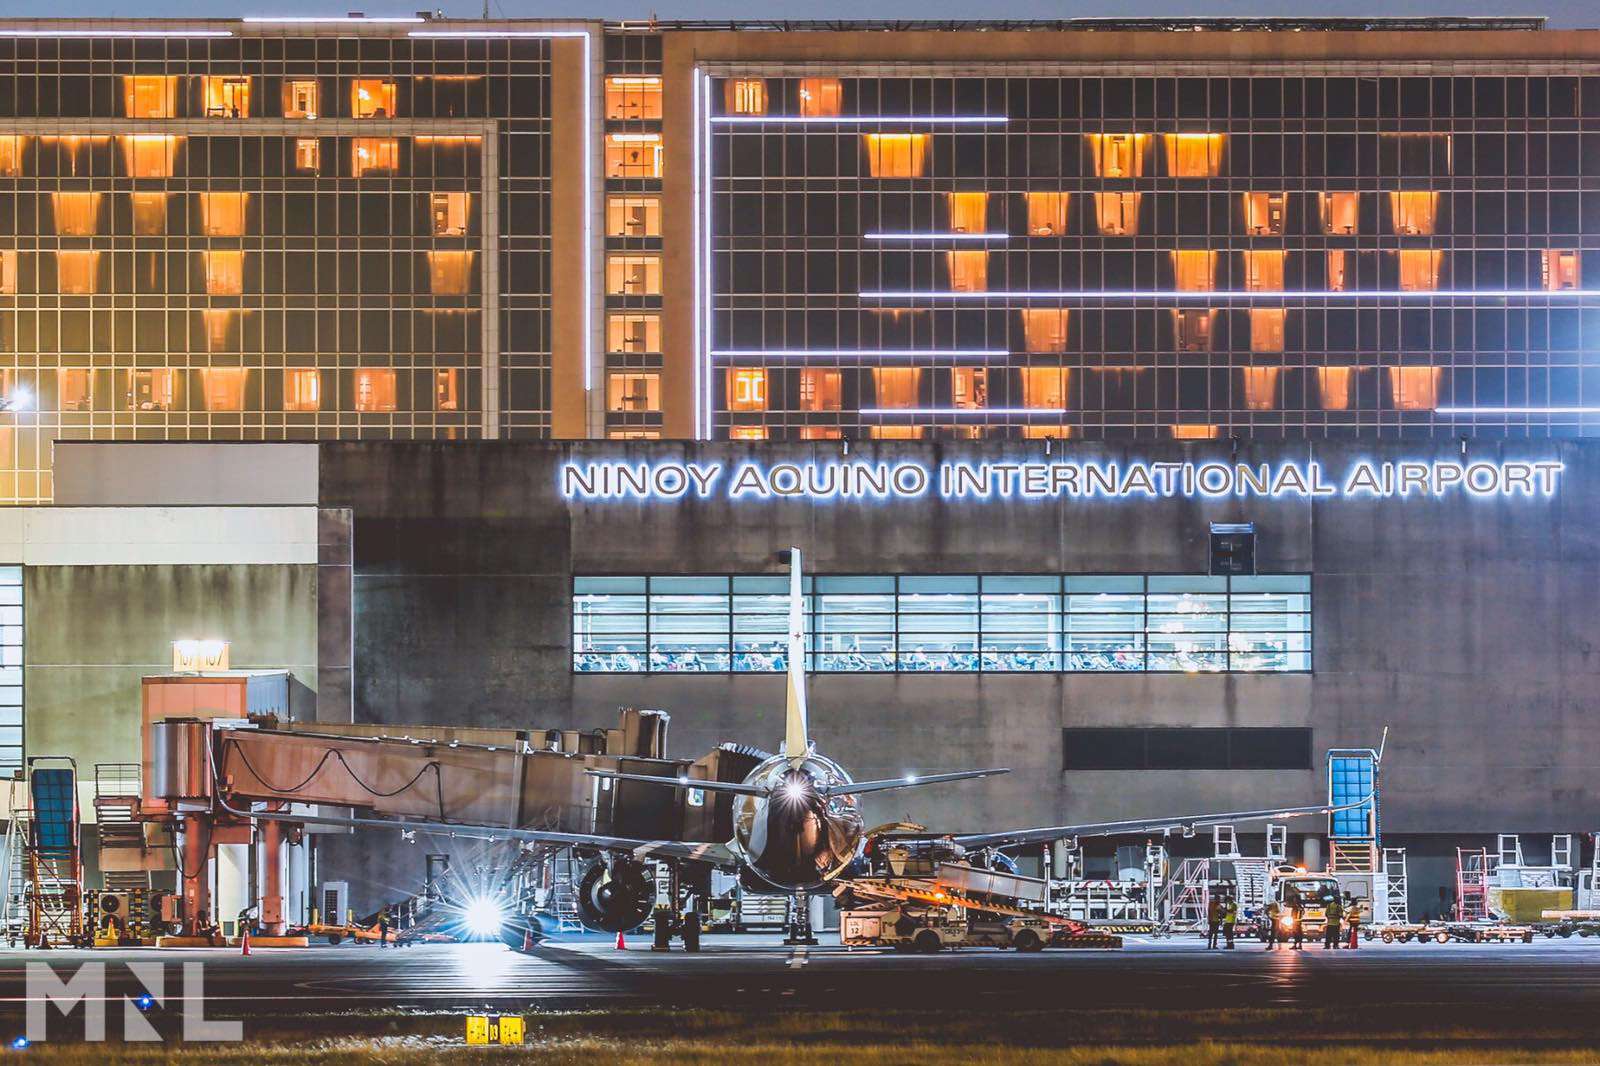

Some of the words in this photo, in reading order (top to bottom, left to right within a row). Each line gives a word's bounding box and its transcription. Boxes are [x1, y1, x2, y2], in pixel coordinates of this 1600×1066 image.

[565, 466, 719, 494] NINOY
[732, 465, 926, 494] AQUINO
[941, 464, 1333, 494] INTERNATIONAL
[1346, 464, 1562, 492] AIRPORT
